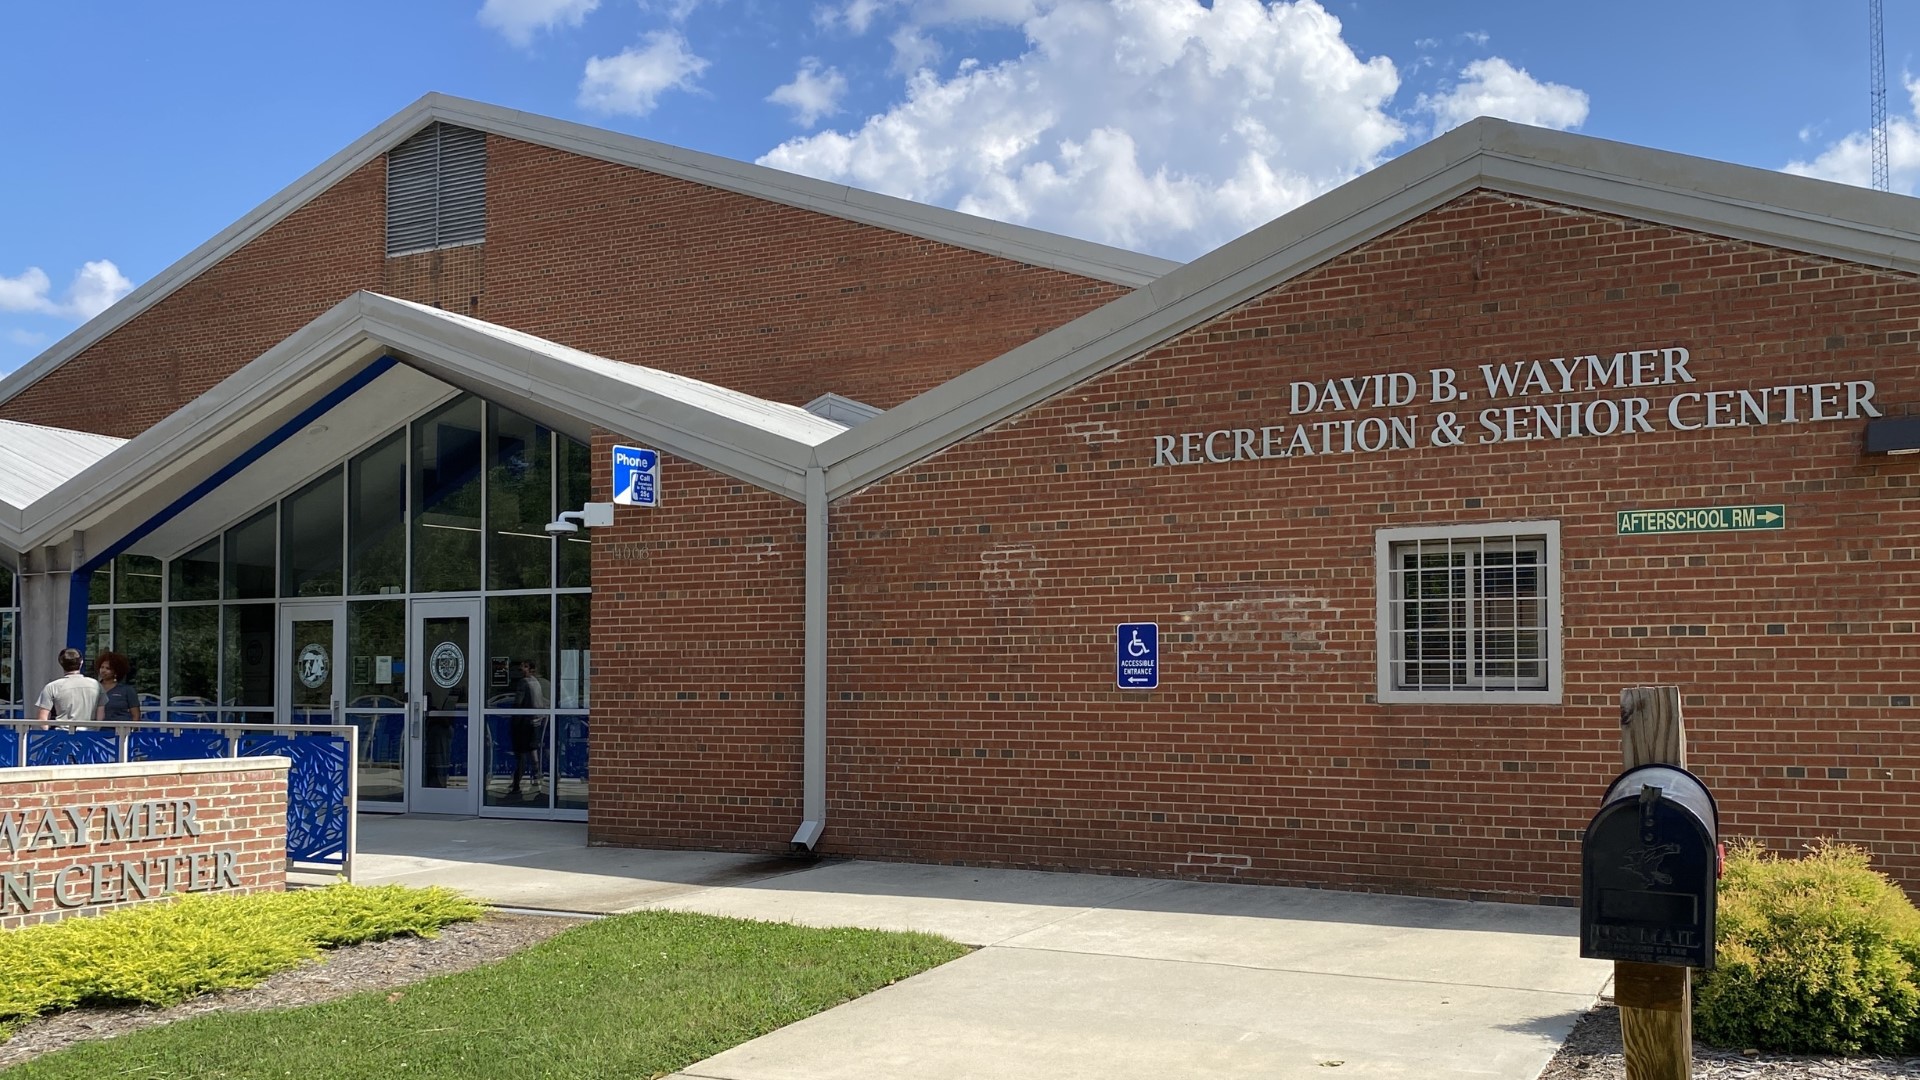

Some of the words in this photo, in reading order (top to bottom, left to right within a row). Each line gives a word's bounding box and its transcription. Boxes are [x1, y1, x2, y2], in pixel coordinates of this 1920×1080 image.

[1289, 371, 1417, 415] DAVID
[1429, 368, 1468, 404] B.
[1479, 347, 1696, 398] WAYMER
[1153, 414, 1419, 467] RECREATION
[1430, 411, 1466, 447] &
[1478, 397, 1656, 445] SENIOR
[1668, 380, 1883, 431] CENTER
[616, 452, 648, 468] Phone
[639, 474, 651, 482] Call
[1620, 509, 1728, 532] AFTERSCHOOL
[1732, 508, 1755, 527] RM
[0, 800, 201, 853] WAYMER
[54, 850, 241, 907] CENTER
